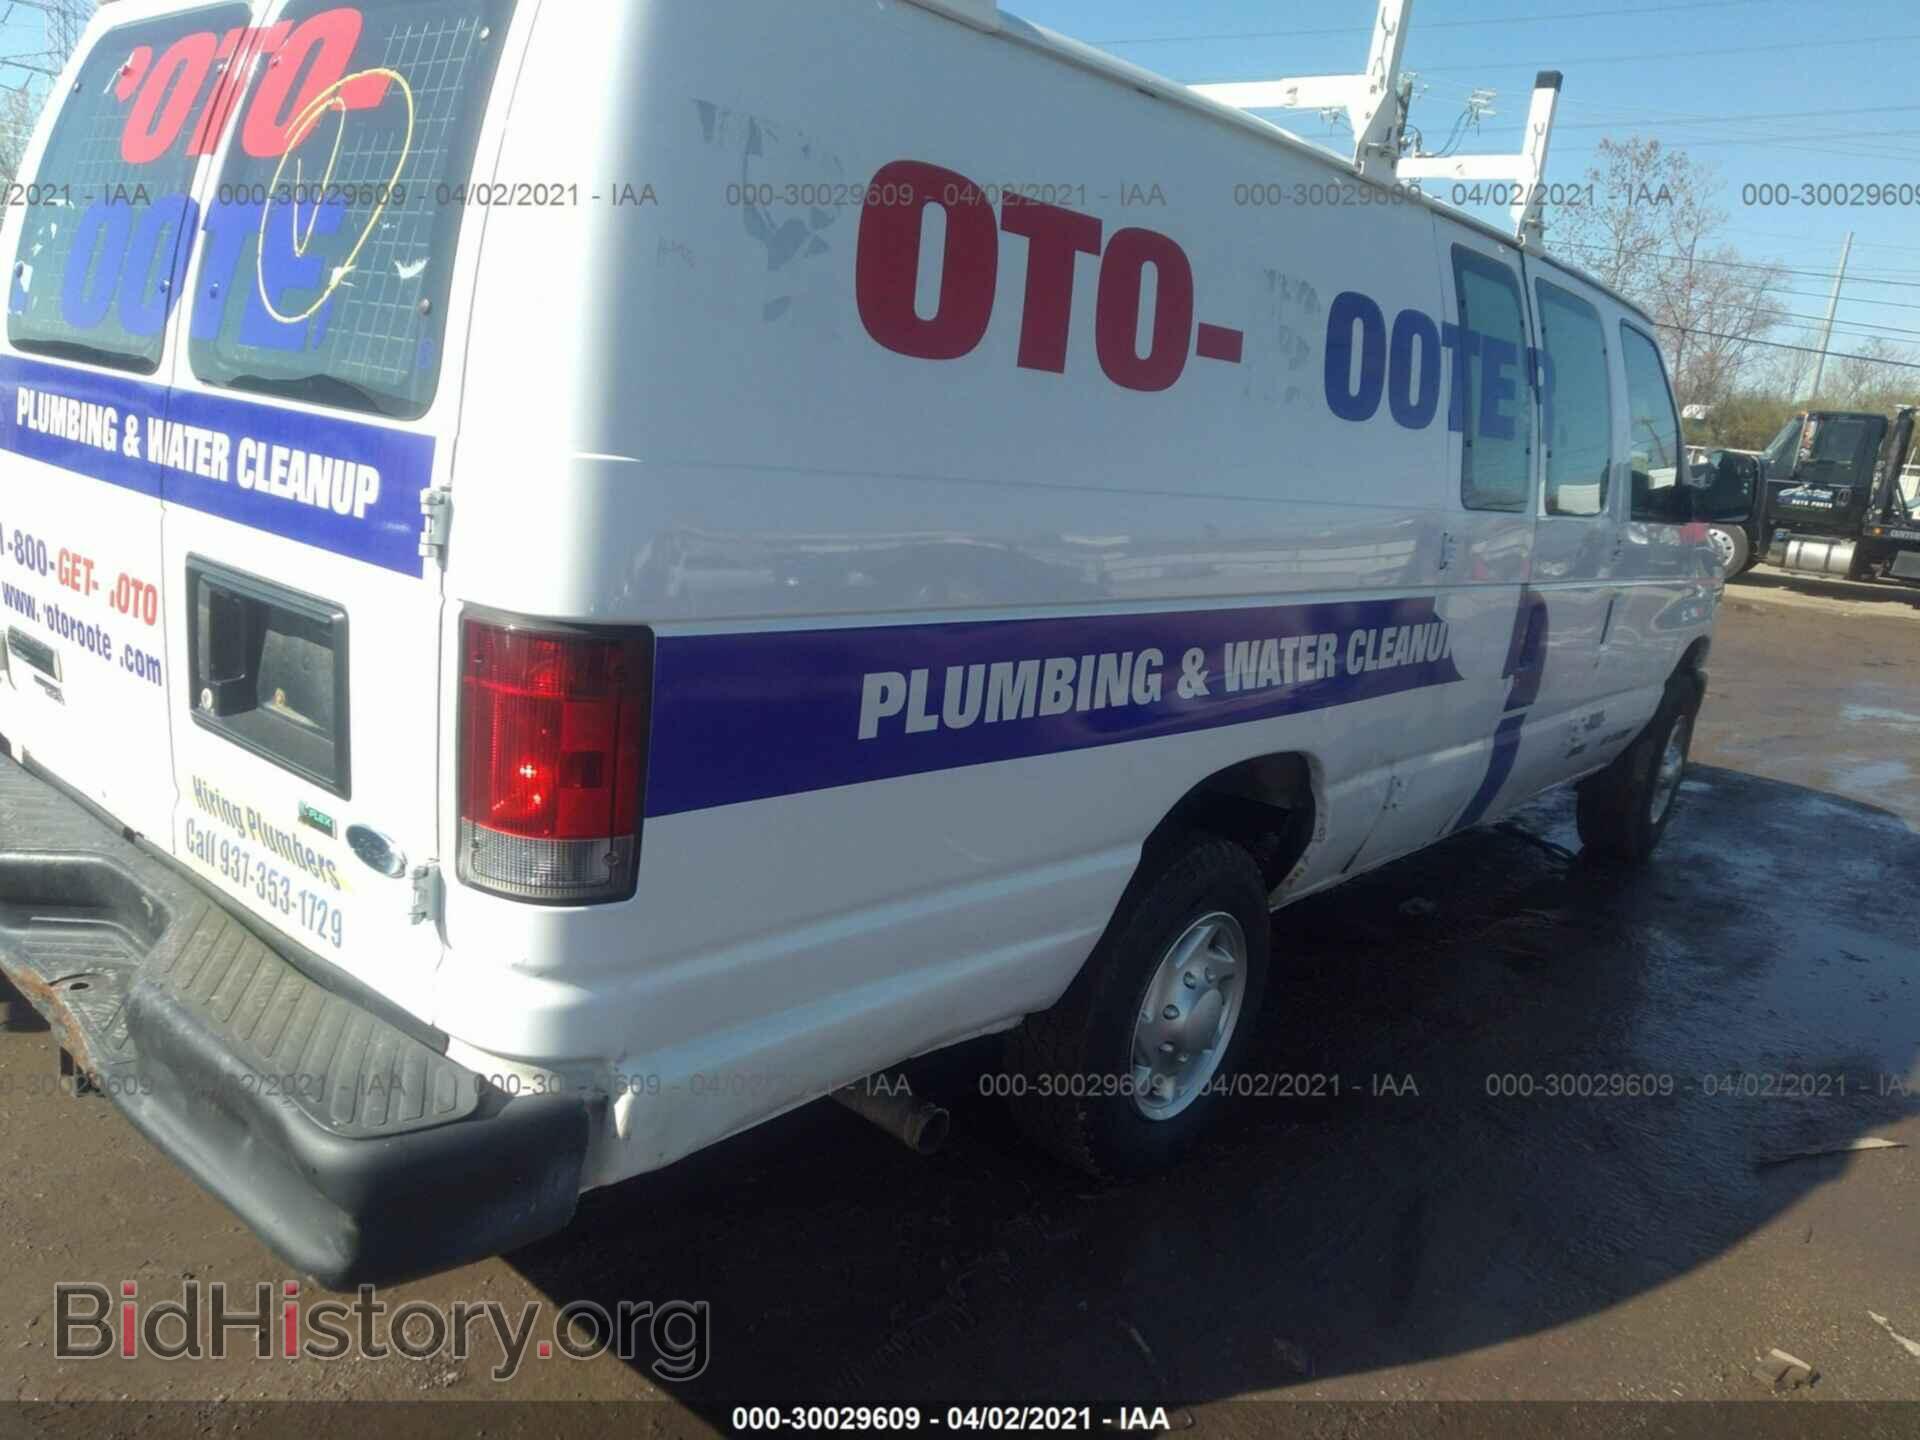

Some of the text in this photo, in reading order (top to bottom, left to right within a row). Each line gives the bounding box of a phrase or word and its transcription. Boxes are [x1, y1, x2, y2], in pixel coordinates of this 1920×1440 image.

[16, 386, 381, 519] PLUMBING & WATER CLEANUP
[856, 621, 1454, 741] PLUMBING & WATER CLEANU
[185, 817, 343, 949] Call 937-353-1729
[192, 774, 246, 839] Hiring
[246, 806, 342, 891] Plumbers
